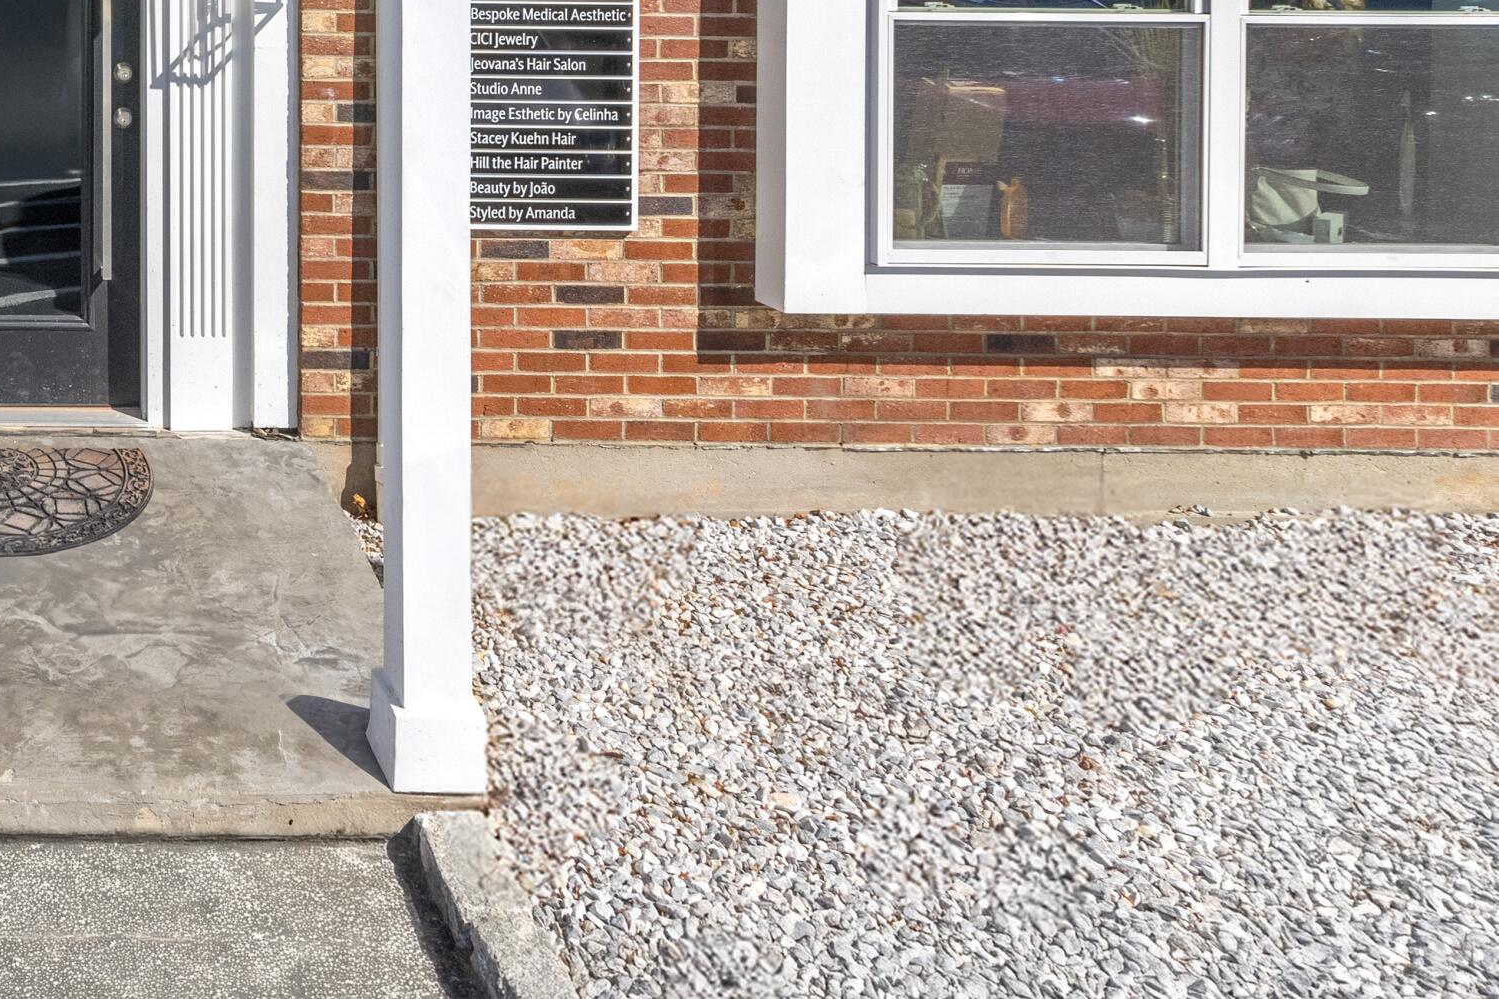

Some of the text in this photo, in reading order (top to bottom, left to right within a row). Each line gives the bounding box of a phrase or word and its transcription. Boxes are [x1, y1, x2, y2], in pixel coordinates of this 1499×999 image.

[471, 7, 627, 23] Bespoke Medical Aesthetic
[470, 32, 539, 49] CICI Jewelry
[526, 57, 552, 70] Hair
[553, 58, 586, 71] Salon
[470, 82, 543, 95] Studio Anne
[470, 107, 619, 123] Image Esthetic by Celinha
[470, 132, 577, 147] Stacey Kuehn Hair
[470, 156, 583, 171] Hill the Hair Painter
[470, 181, 556, 197] Beauty by João
[470, 206, 576, 222] Styled by Amanda
